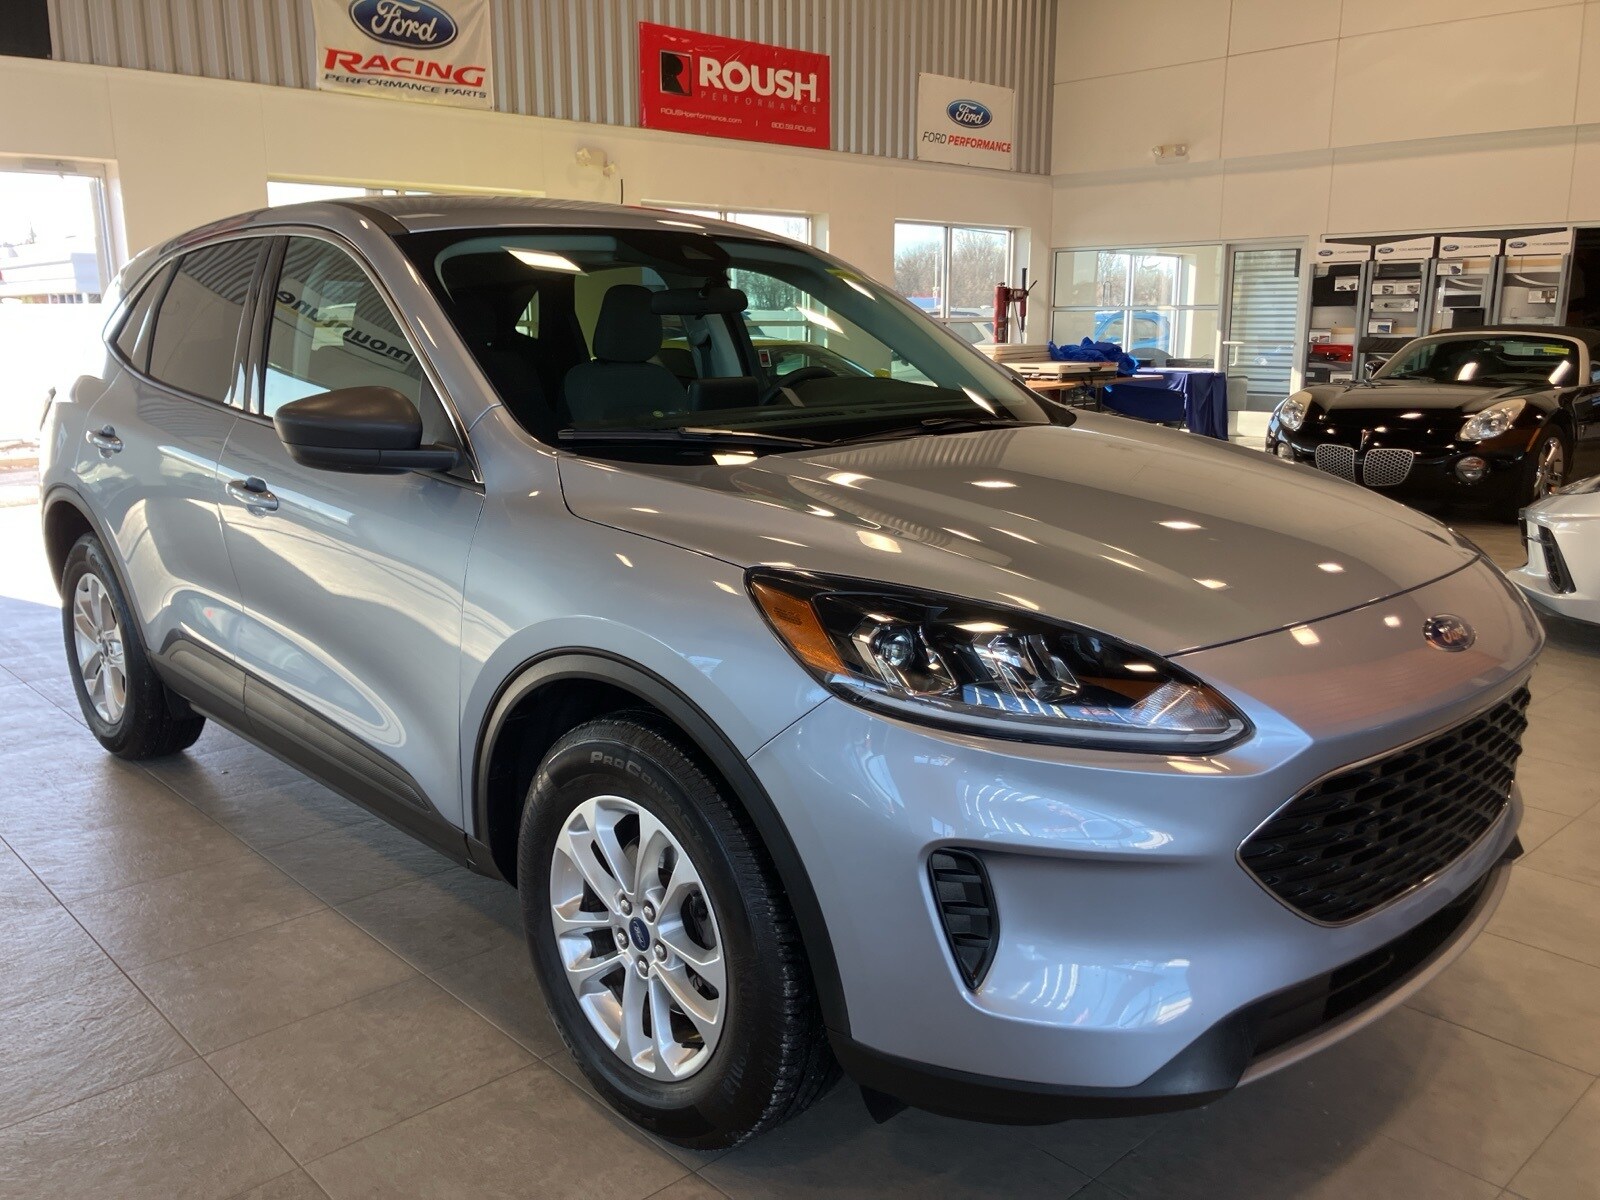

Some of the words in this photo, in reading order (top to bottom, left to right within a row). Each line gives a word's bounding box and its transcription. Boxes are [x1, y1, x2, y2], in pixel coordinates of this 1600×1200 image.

[371, 0, 438, 42] Ford
[324, 47, 486, 87] RACING
[699, 56, 818, 103] ROUSH
[324, 73, 440, 94] PERFORMANCE
[444, 88, 487, 99] PARTS
[660, 107, 743, 124] ROUSHperformance.com
[701, 91, 817, 115] PERFORMANCE
[955, 103, 984, 125] Ford
[922, 131, 948, 145] FORD
[948, 135, 1013, 153] PERFORMANCE
